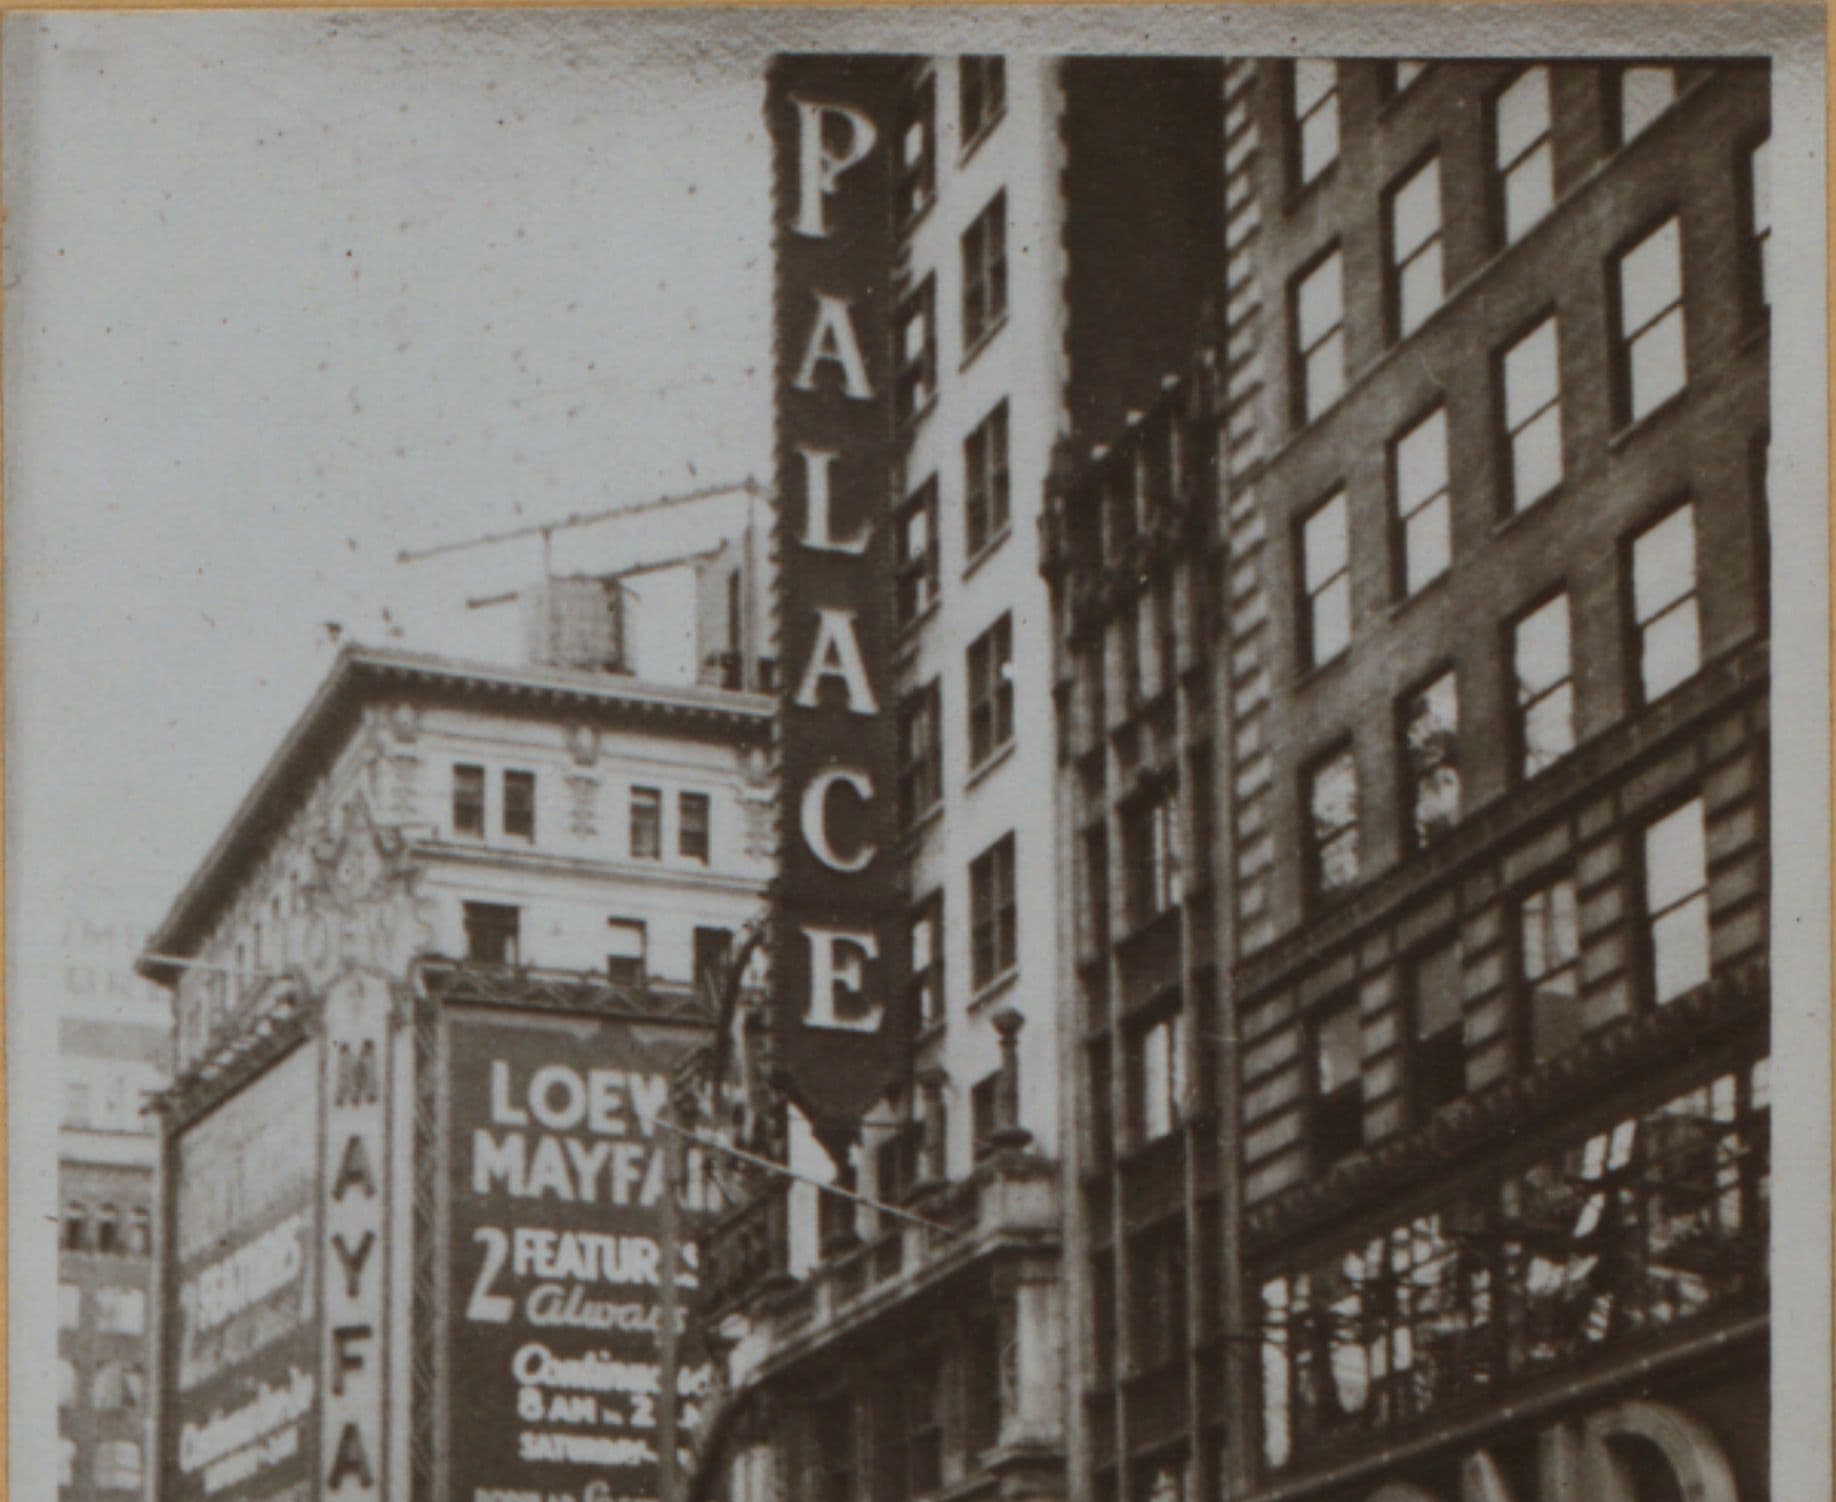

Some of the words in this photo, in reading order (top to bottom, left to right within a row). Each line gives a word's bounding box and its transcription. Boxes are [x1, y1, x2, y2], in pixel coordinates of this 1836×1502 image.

[795, 93, 884, 1036] PALACE
[466, 1226, 514, 1324] 2
[514, 1227, 699, 1289] FEATURS
[517, 1386, 543, 1421] 8
[548, 1395, 597, 1424] AM
